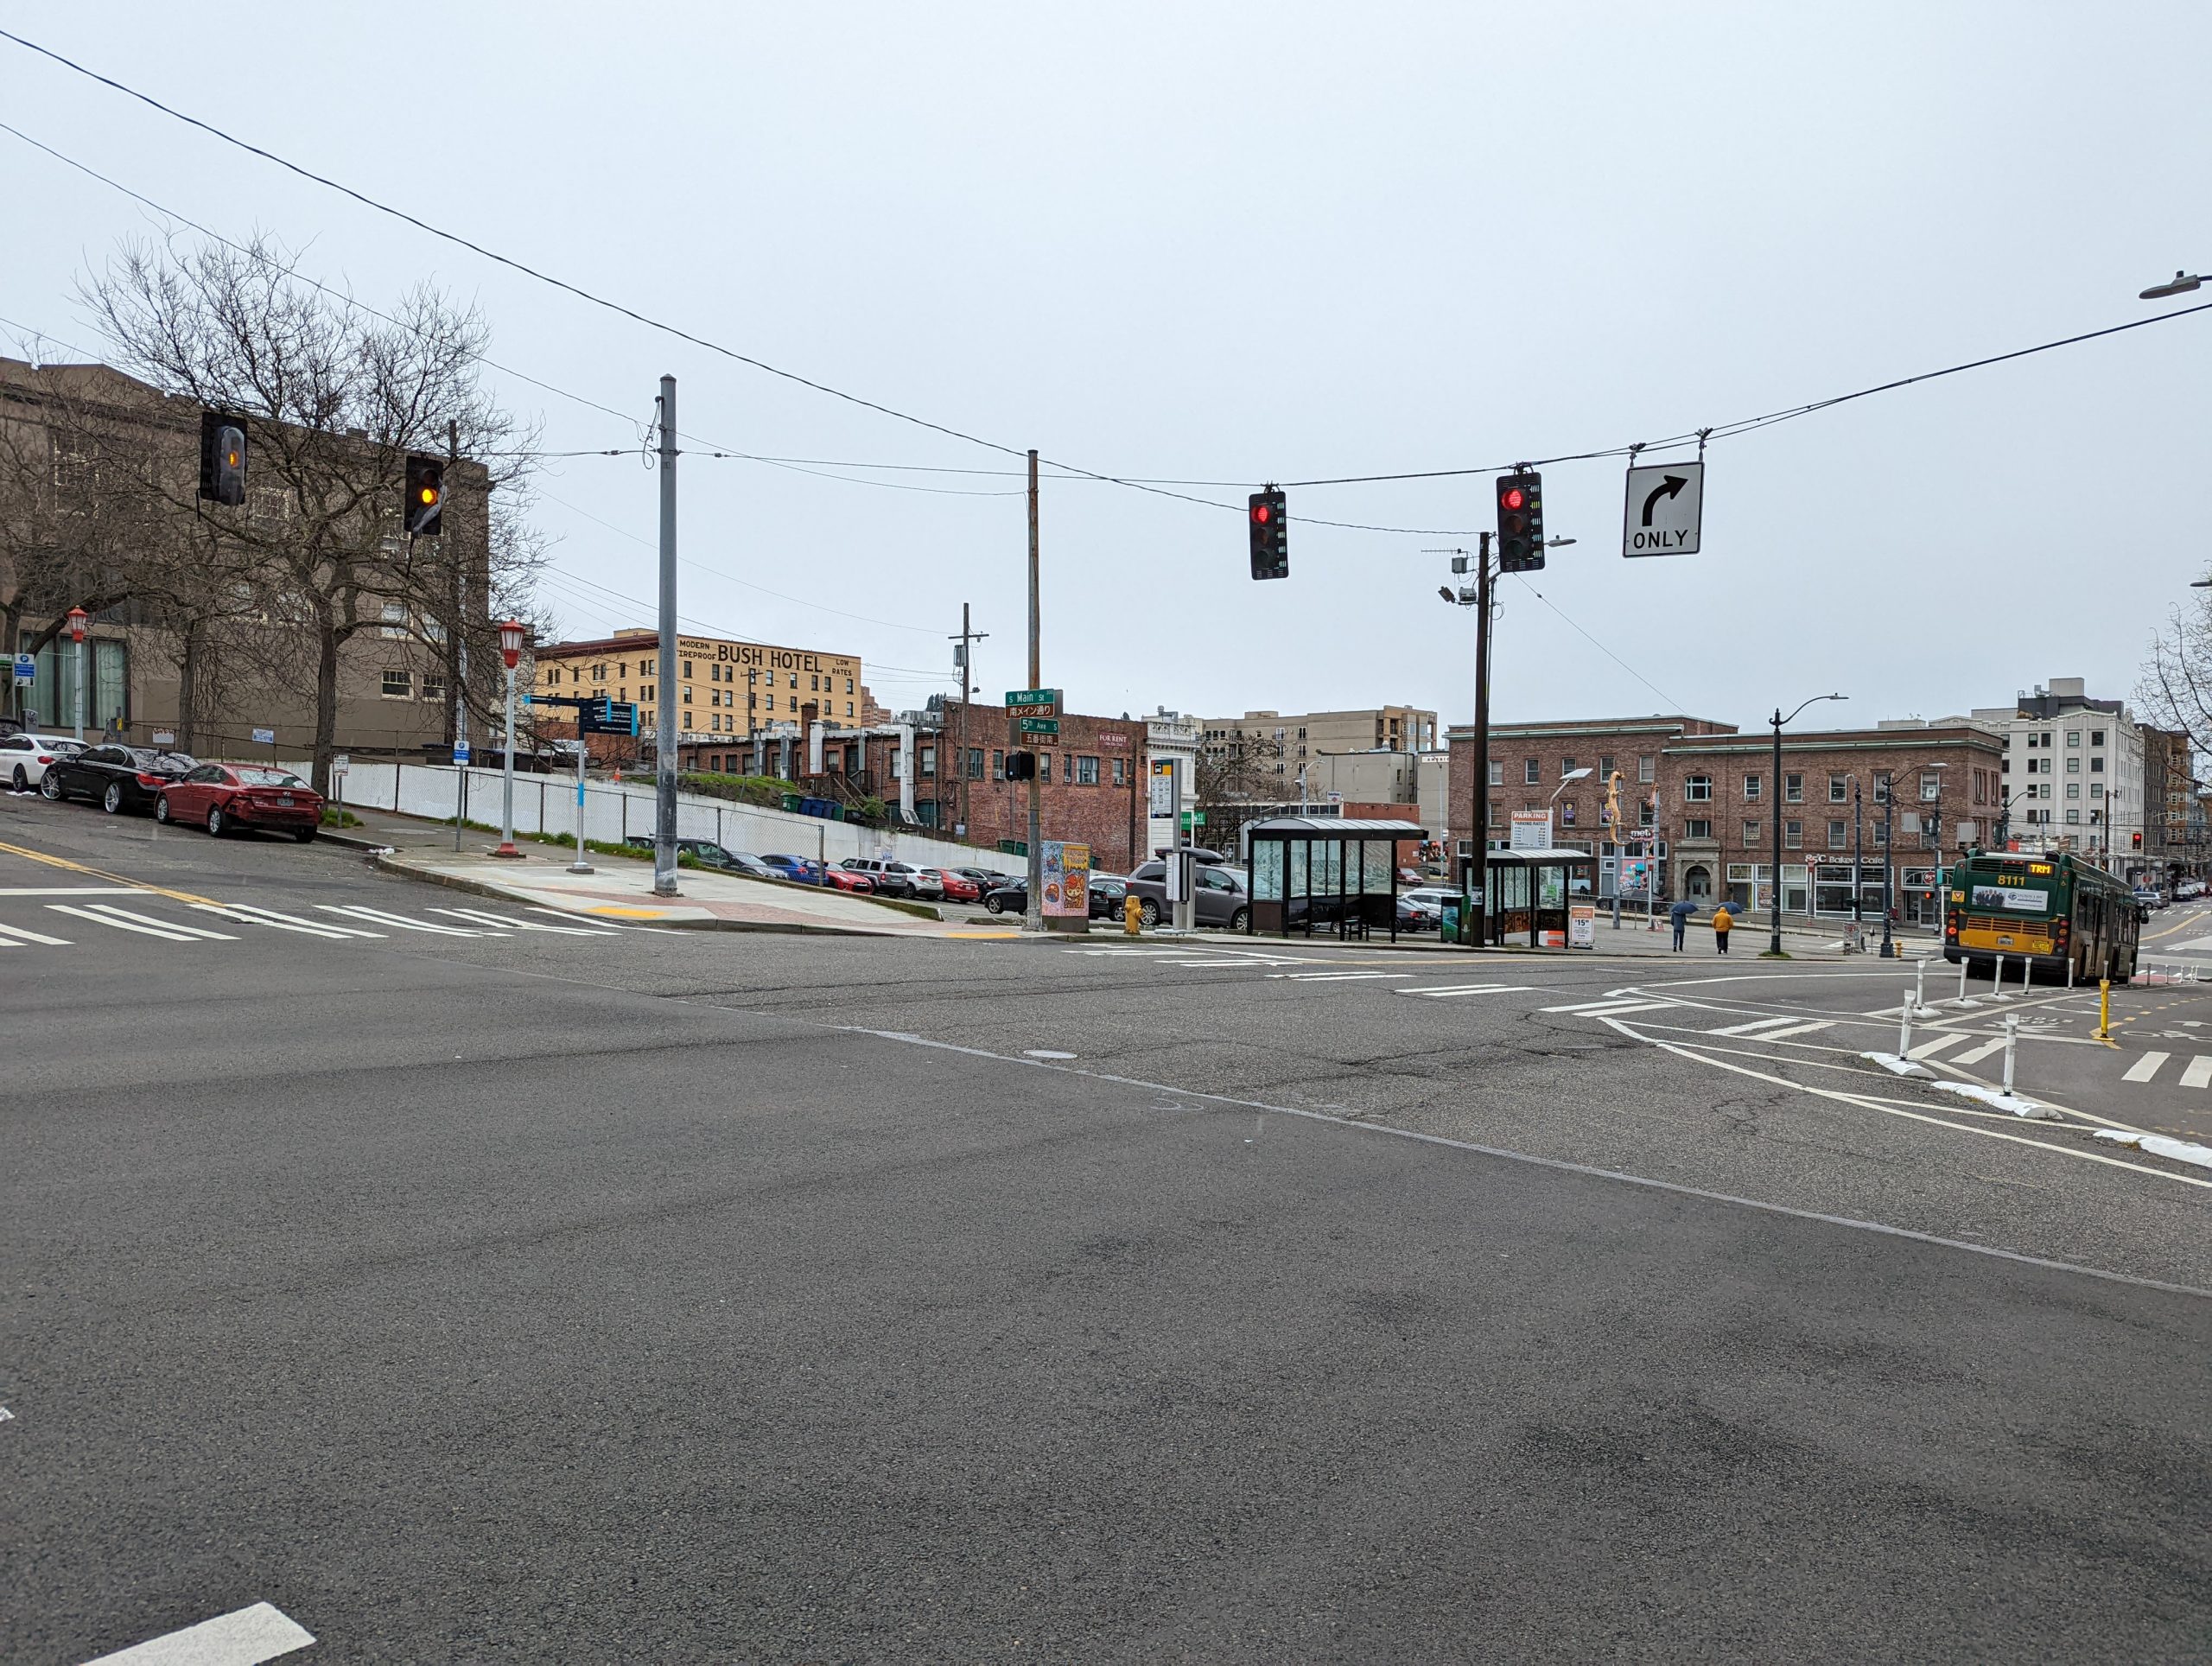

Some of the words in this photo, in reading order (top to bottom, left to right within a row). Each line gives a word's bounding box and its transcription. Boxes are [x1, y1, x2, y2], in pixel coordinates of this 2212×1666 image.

[1633, 529, 1688, 549] ONLY
[679, 639, 710, 651] MODERN
[717, 644, 763, 666] BUSH
[771, 650, 823, 673] HOTEL
[831, 668, 852, 677] RATES
[1017, 692, 1033, 703] Main
[1009, 705, 1051, 717] 南メイン通り
[1022, 719, 1033, 729] 5th
[2031, 864, 2051, 874] TRM
[1997, 874, 2025, 887] 8111
